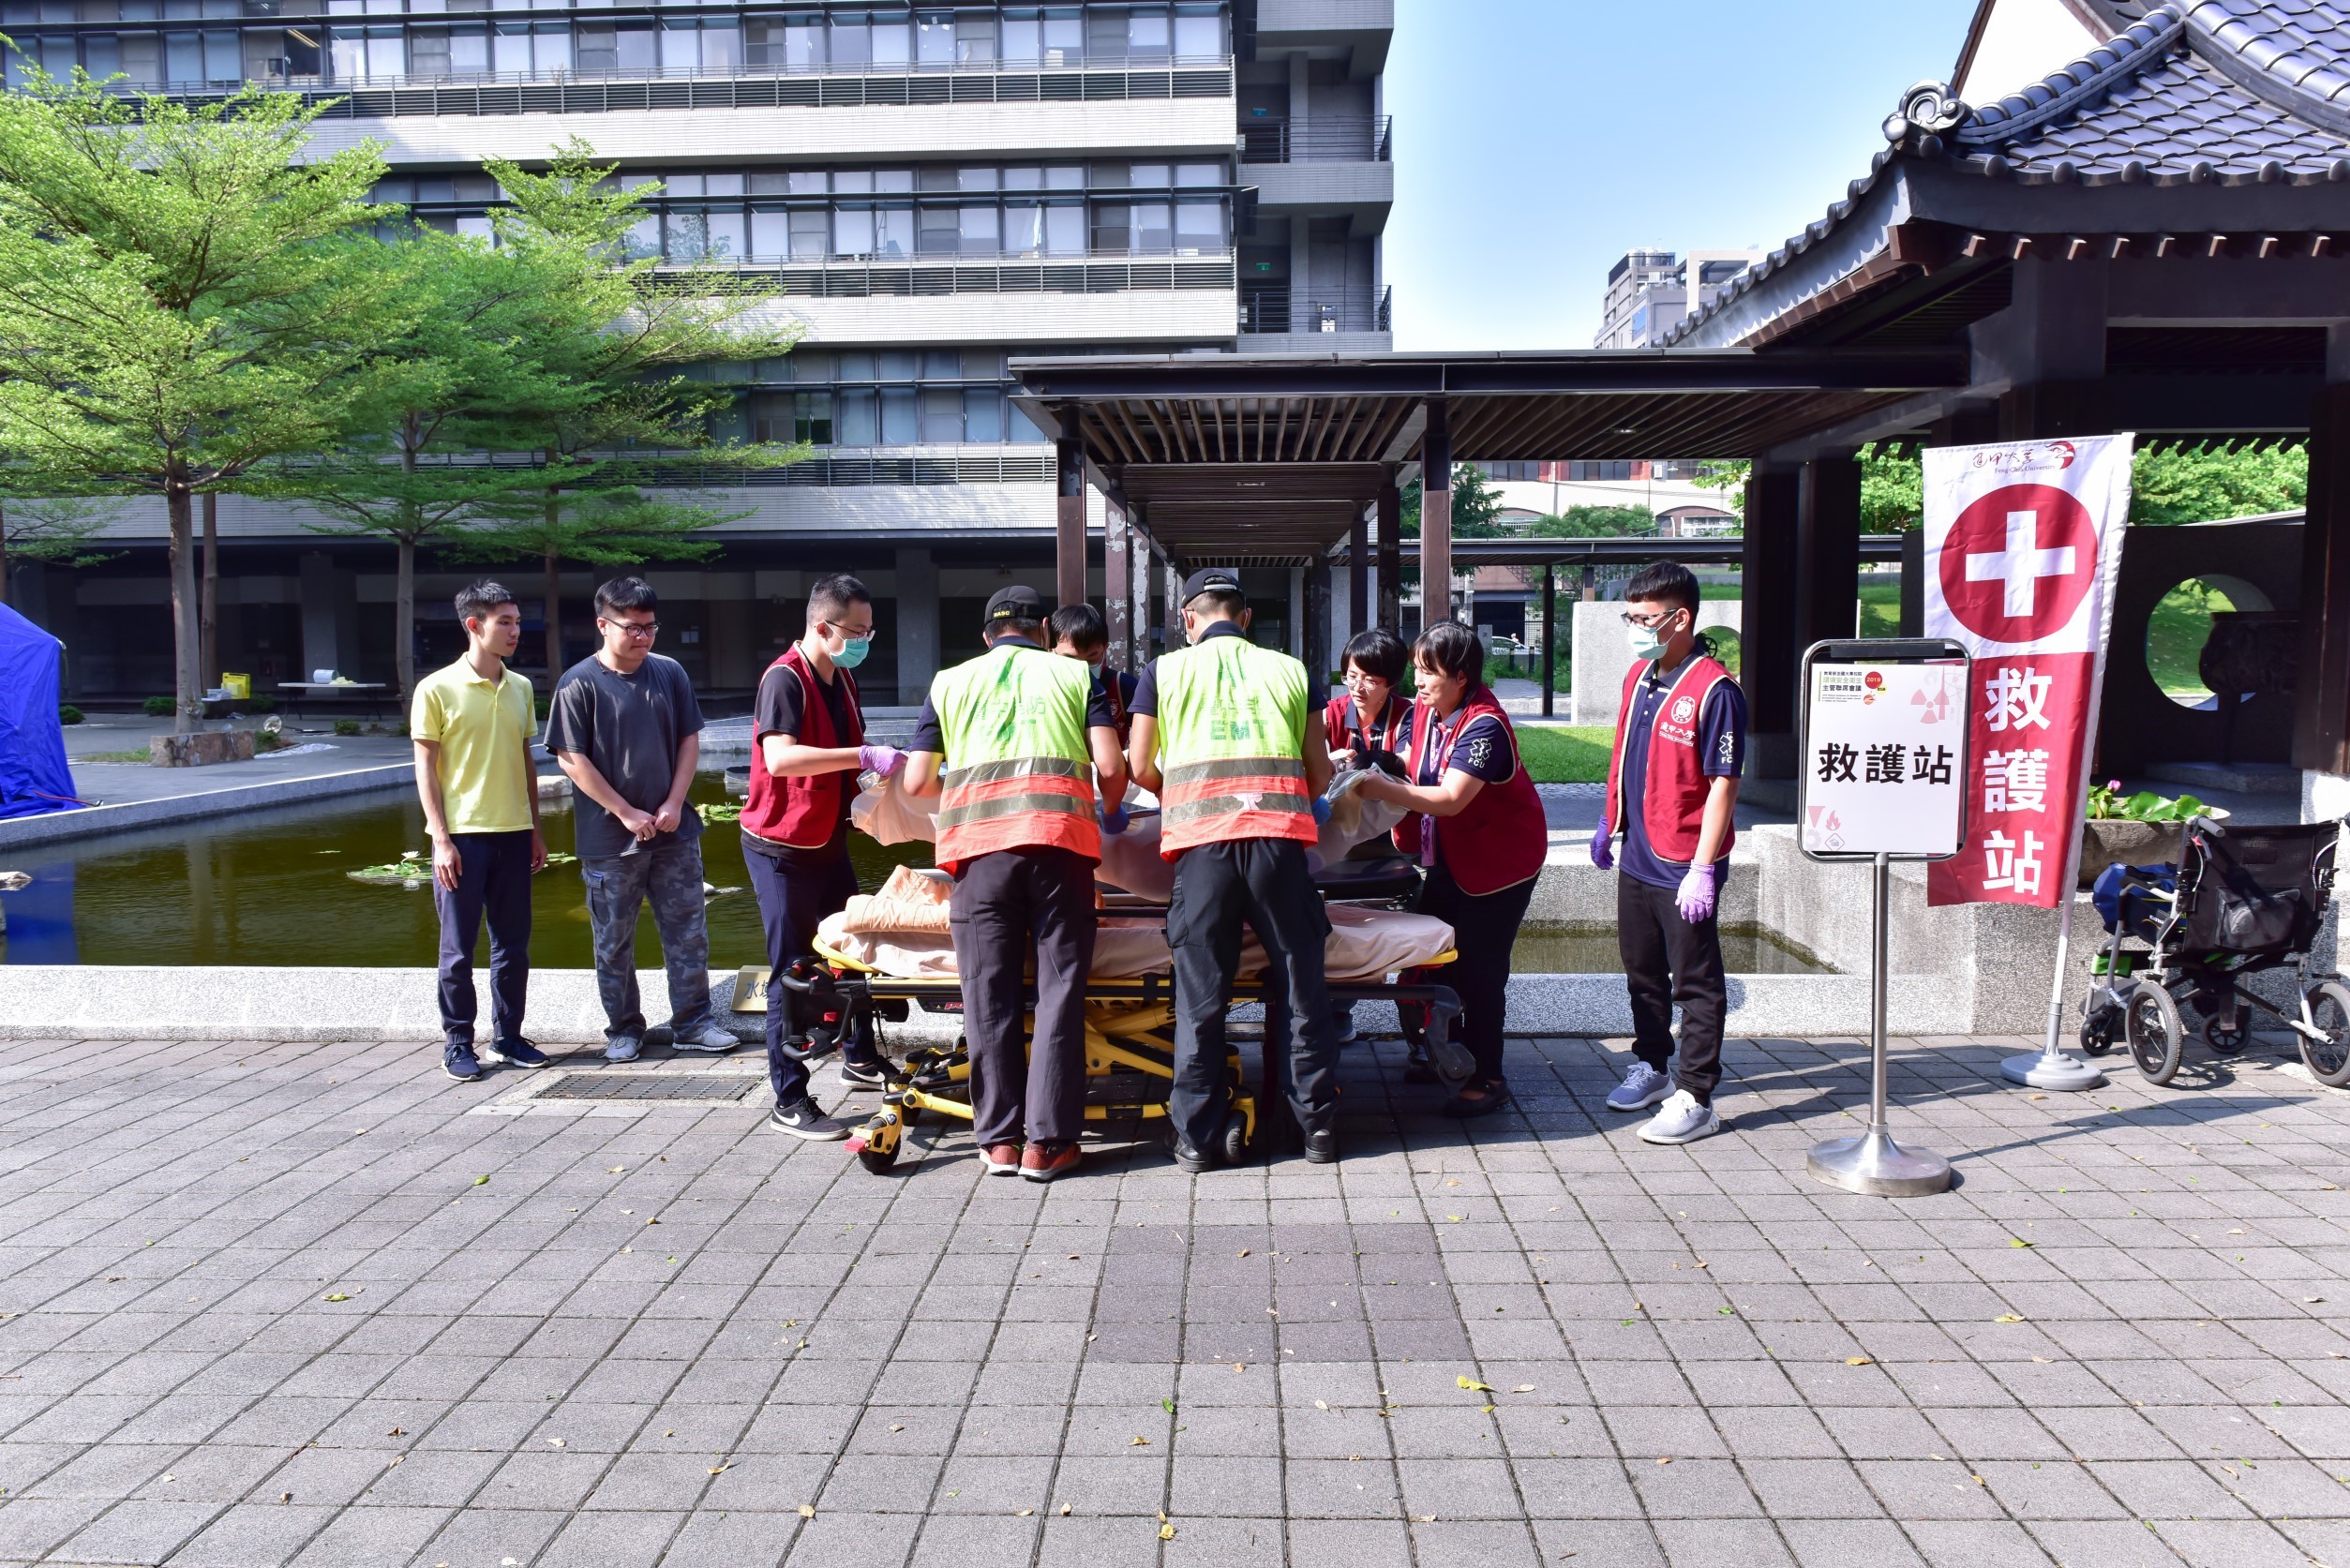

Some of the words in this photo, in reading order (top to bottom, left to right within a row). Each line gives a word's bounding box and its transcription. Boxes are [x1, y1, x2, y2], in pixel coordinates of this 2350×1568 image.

[1210, 719, 1268, 740] EMT
[1467, 757, 1486, 769] FCU
[1818, 742, 1953, 784] 救護站
[1983, 666, 2053, 896] 救護站
